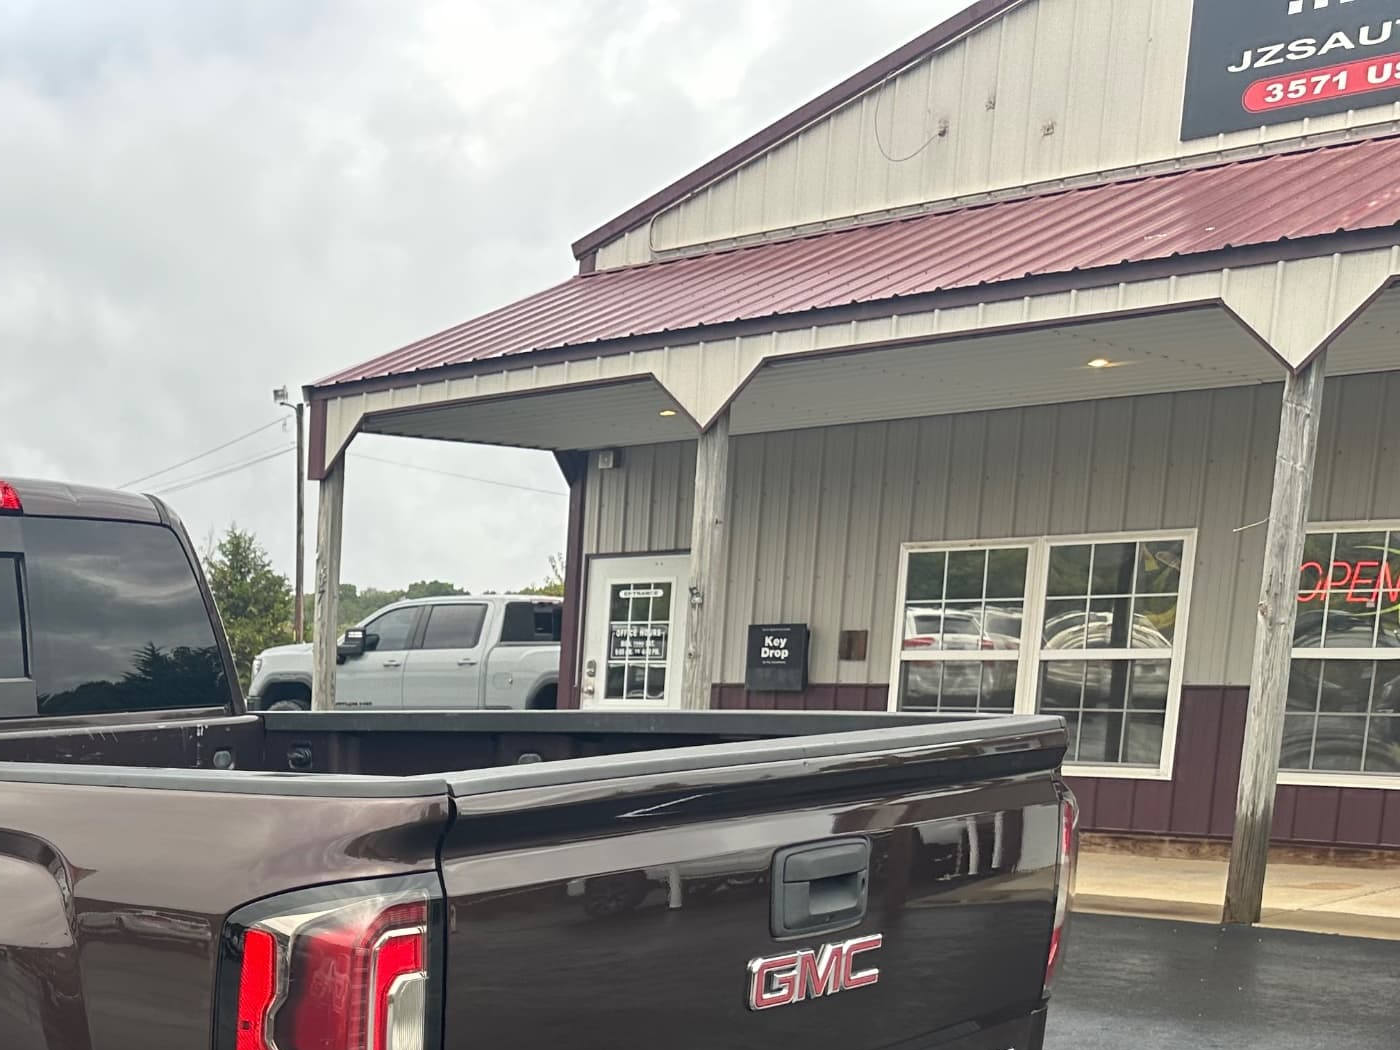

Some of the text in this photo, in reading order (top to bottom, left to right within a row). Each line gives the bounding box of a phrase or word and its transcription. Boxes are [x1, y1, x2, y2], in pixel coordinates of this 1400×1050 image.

[1227, 19, 1400, 73] JZSAU
[1264, 71, 1347, 103] 3571
[1295, 561, 1400, 602] OPEN
[760, 647, 789, 660] Drop
[764, 635, 787, 649] Key
[747, 933, 883, 1011] GMC
